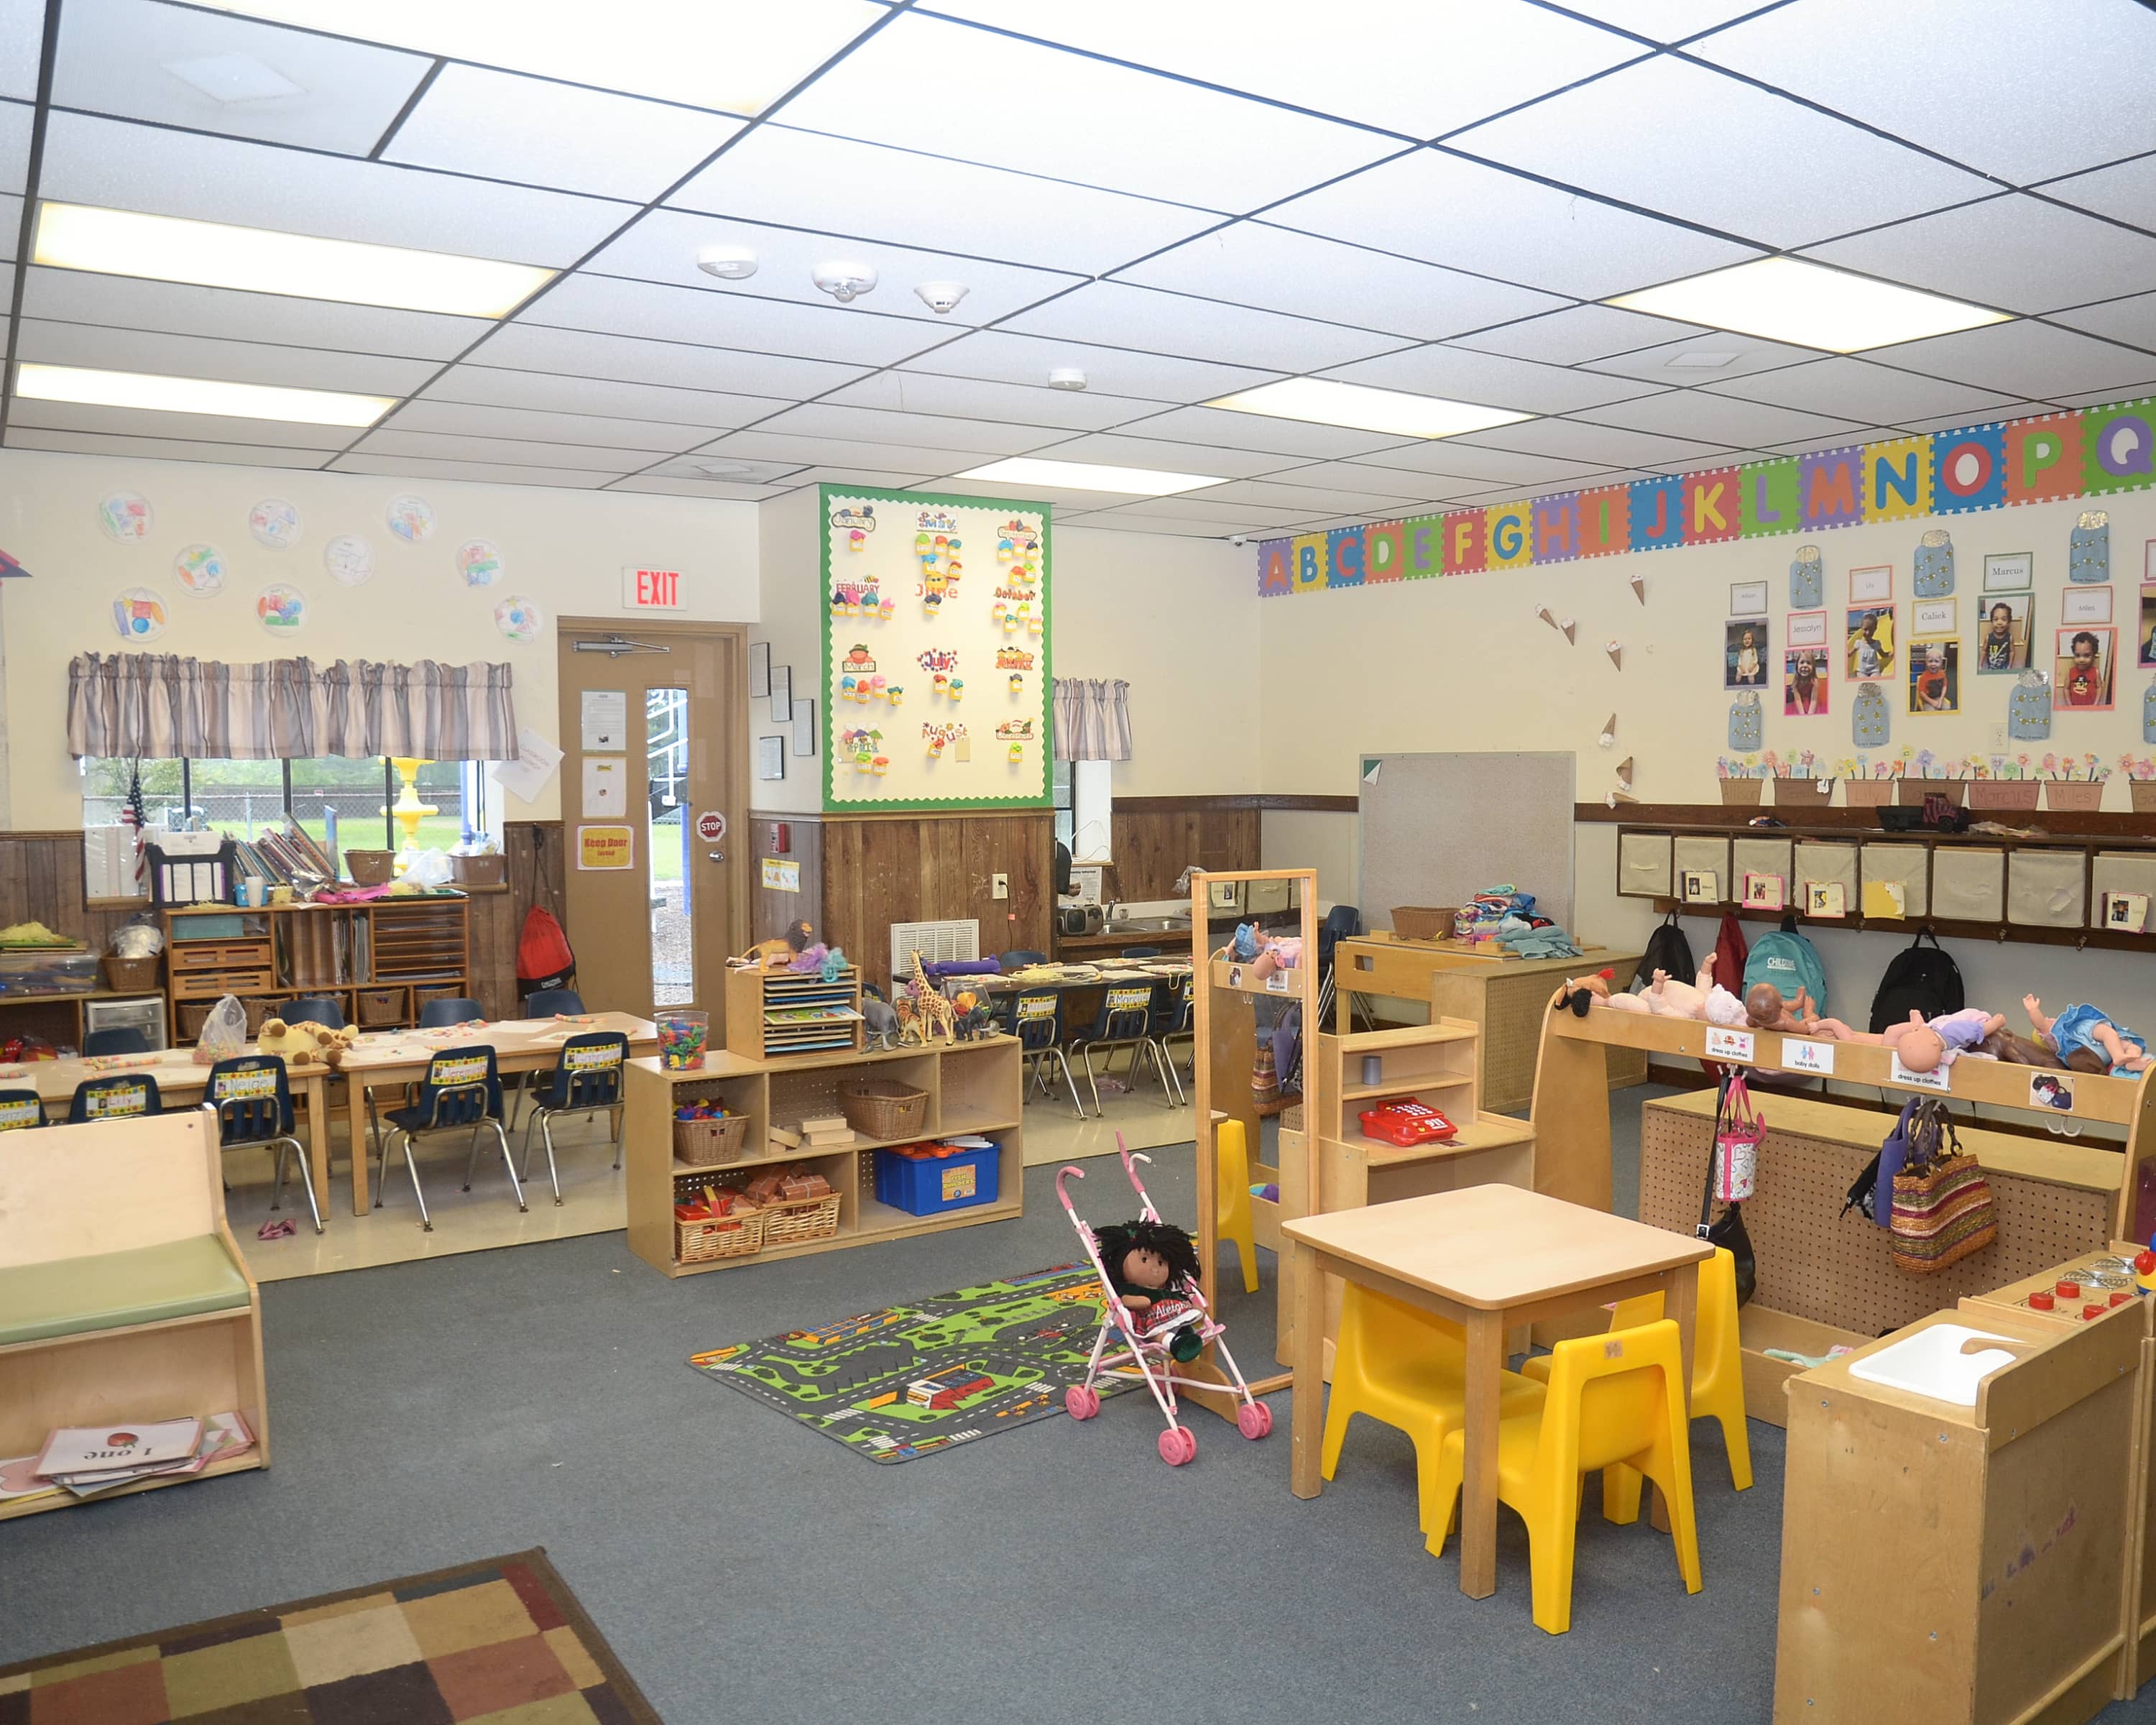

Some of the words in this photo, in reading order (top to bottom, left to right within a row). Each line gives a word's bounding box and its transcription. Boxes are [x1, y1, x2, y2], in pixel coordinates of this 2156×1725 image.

[1266, 553, 1287, 588] A
[1300, 546, 1318, 583] B
[1336, 538, 1356, 576] C
[1372, 533, 1394, 571] D
[1414, 528, 1431, 568] E
[1456, 523, 1472, 565] F
[1493, 515, 1522, 559] G
[1539, 507, 1569, 553] H
[1600, 500, 1609, 545] I
[1646, 490, 1666, 537] J
[1694, 483, 1726, 533] K
[1756, 475, 1780, 523] L
[1807, 462, 1854, 518] M
[1875, 452, 1917, 510] N
[1943, 442, 1992, 496] O
[2023, 431, 2063, 489] P
[2096, 416, 2155, 477] Q
[925, 518, 956, 530] May
[1992, 567, 2024, 576] Marcus
[637, 570, 679, 606] EXIT
[1921, 611, 1947, 621] Caliek
[1792, 624, 1822, 634] Jessalyn
[924, 651, 952, 670] July
[922, 725, 967, 742] August
[1979, 788, 2034, 804] Marcus
[2055, 788, 2092, 804] Miles
[701, 822, 721, 832] STOP
[584, 838, 606, 848] Keep
[608, 838, 627, 847] Door
[1922, 1077, 1941, 1086] clothes
[109, 1096, 133, 1106] Lily
[1424, 1118, 1445, 1127] 911
[83, 1448, 132, 1460] one
